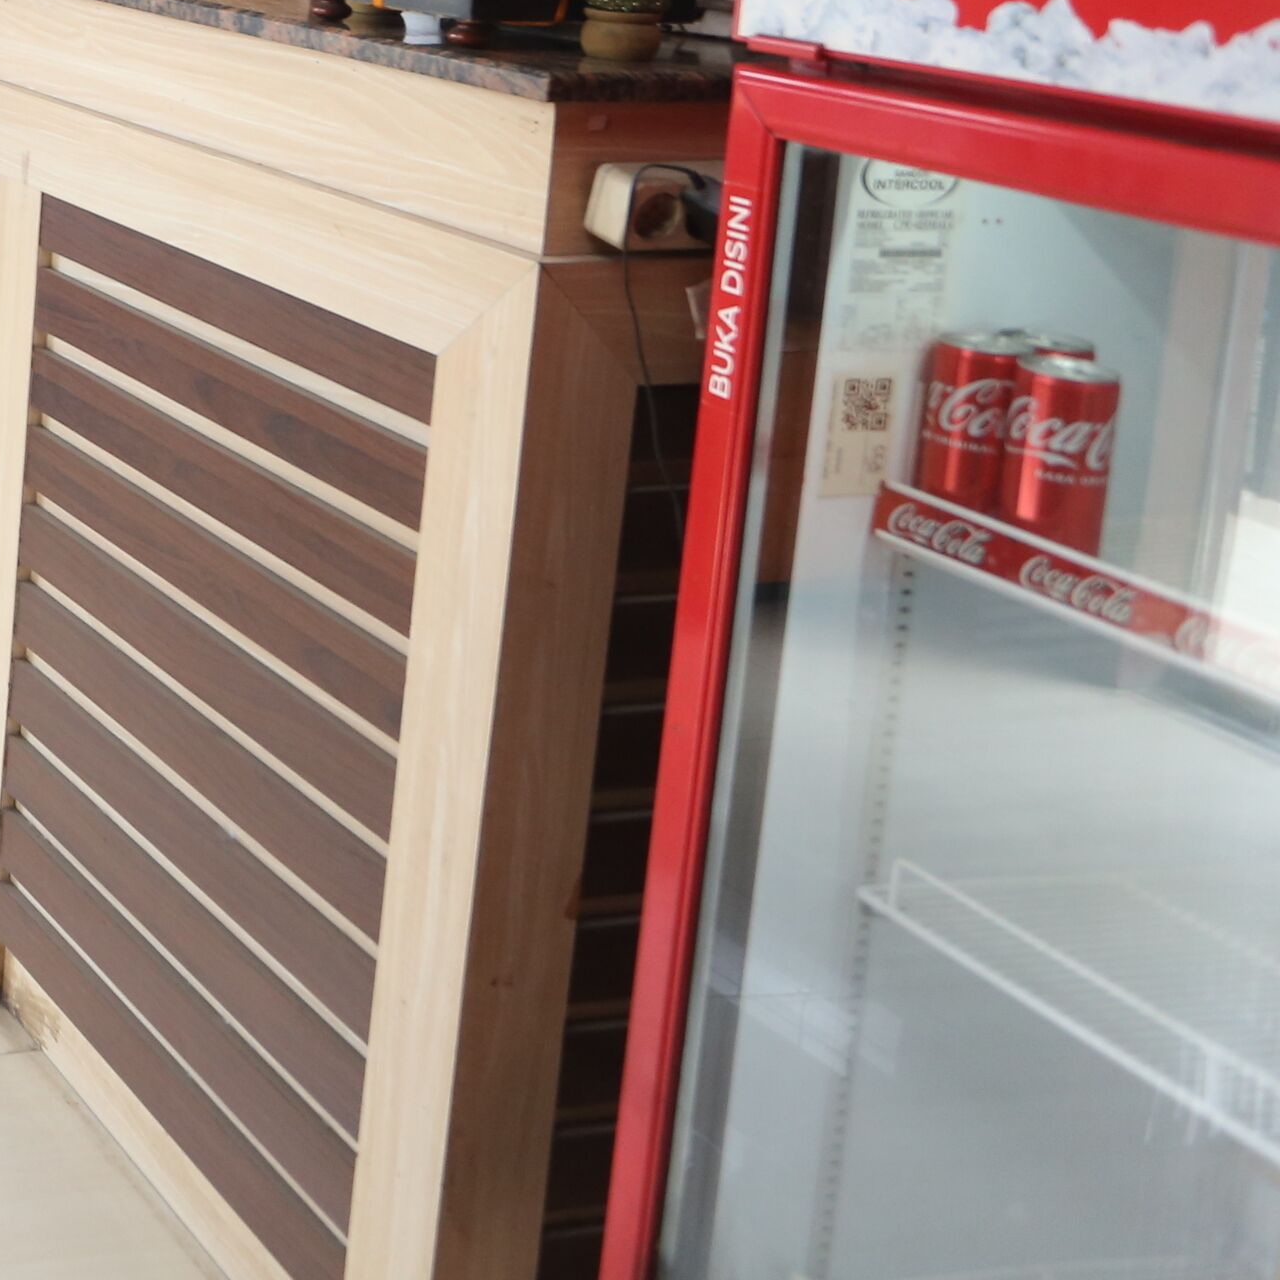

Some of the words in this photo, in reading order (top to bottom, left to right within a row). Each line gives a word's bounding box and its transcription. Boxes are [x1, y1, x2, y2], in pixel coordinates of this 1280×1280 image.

[873, 178, 945, 191] INTERCOOL
[720, 195, 753, 296] DISINI
[708, 304, 742, 401] BUKA
